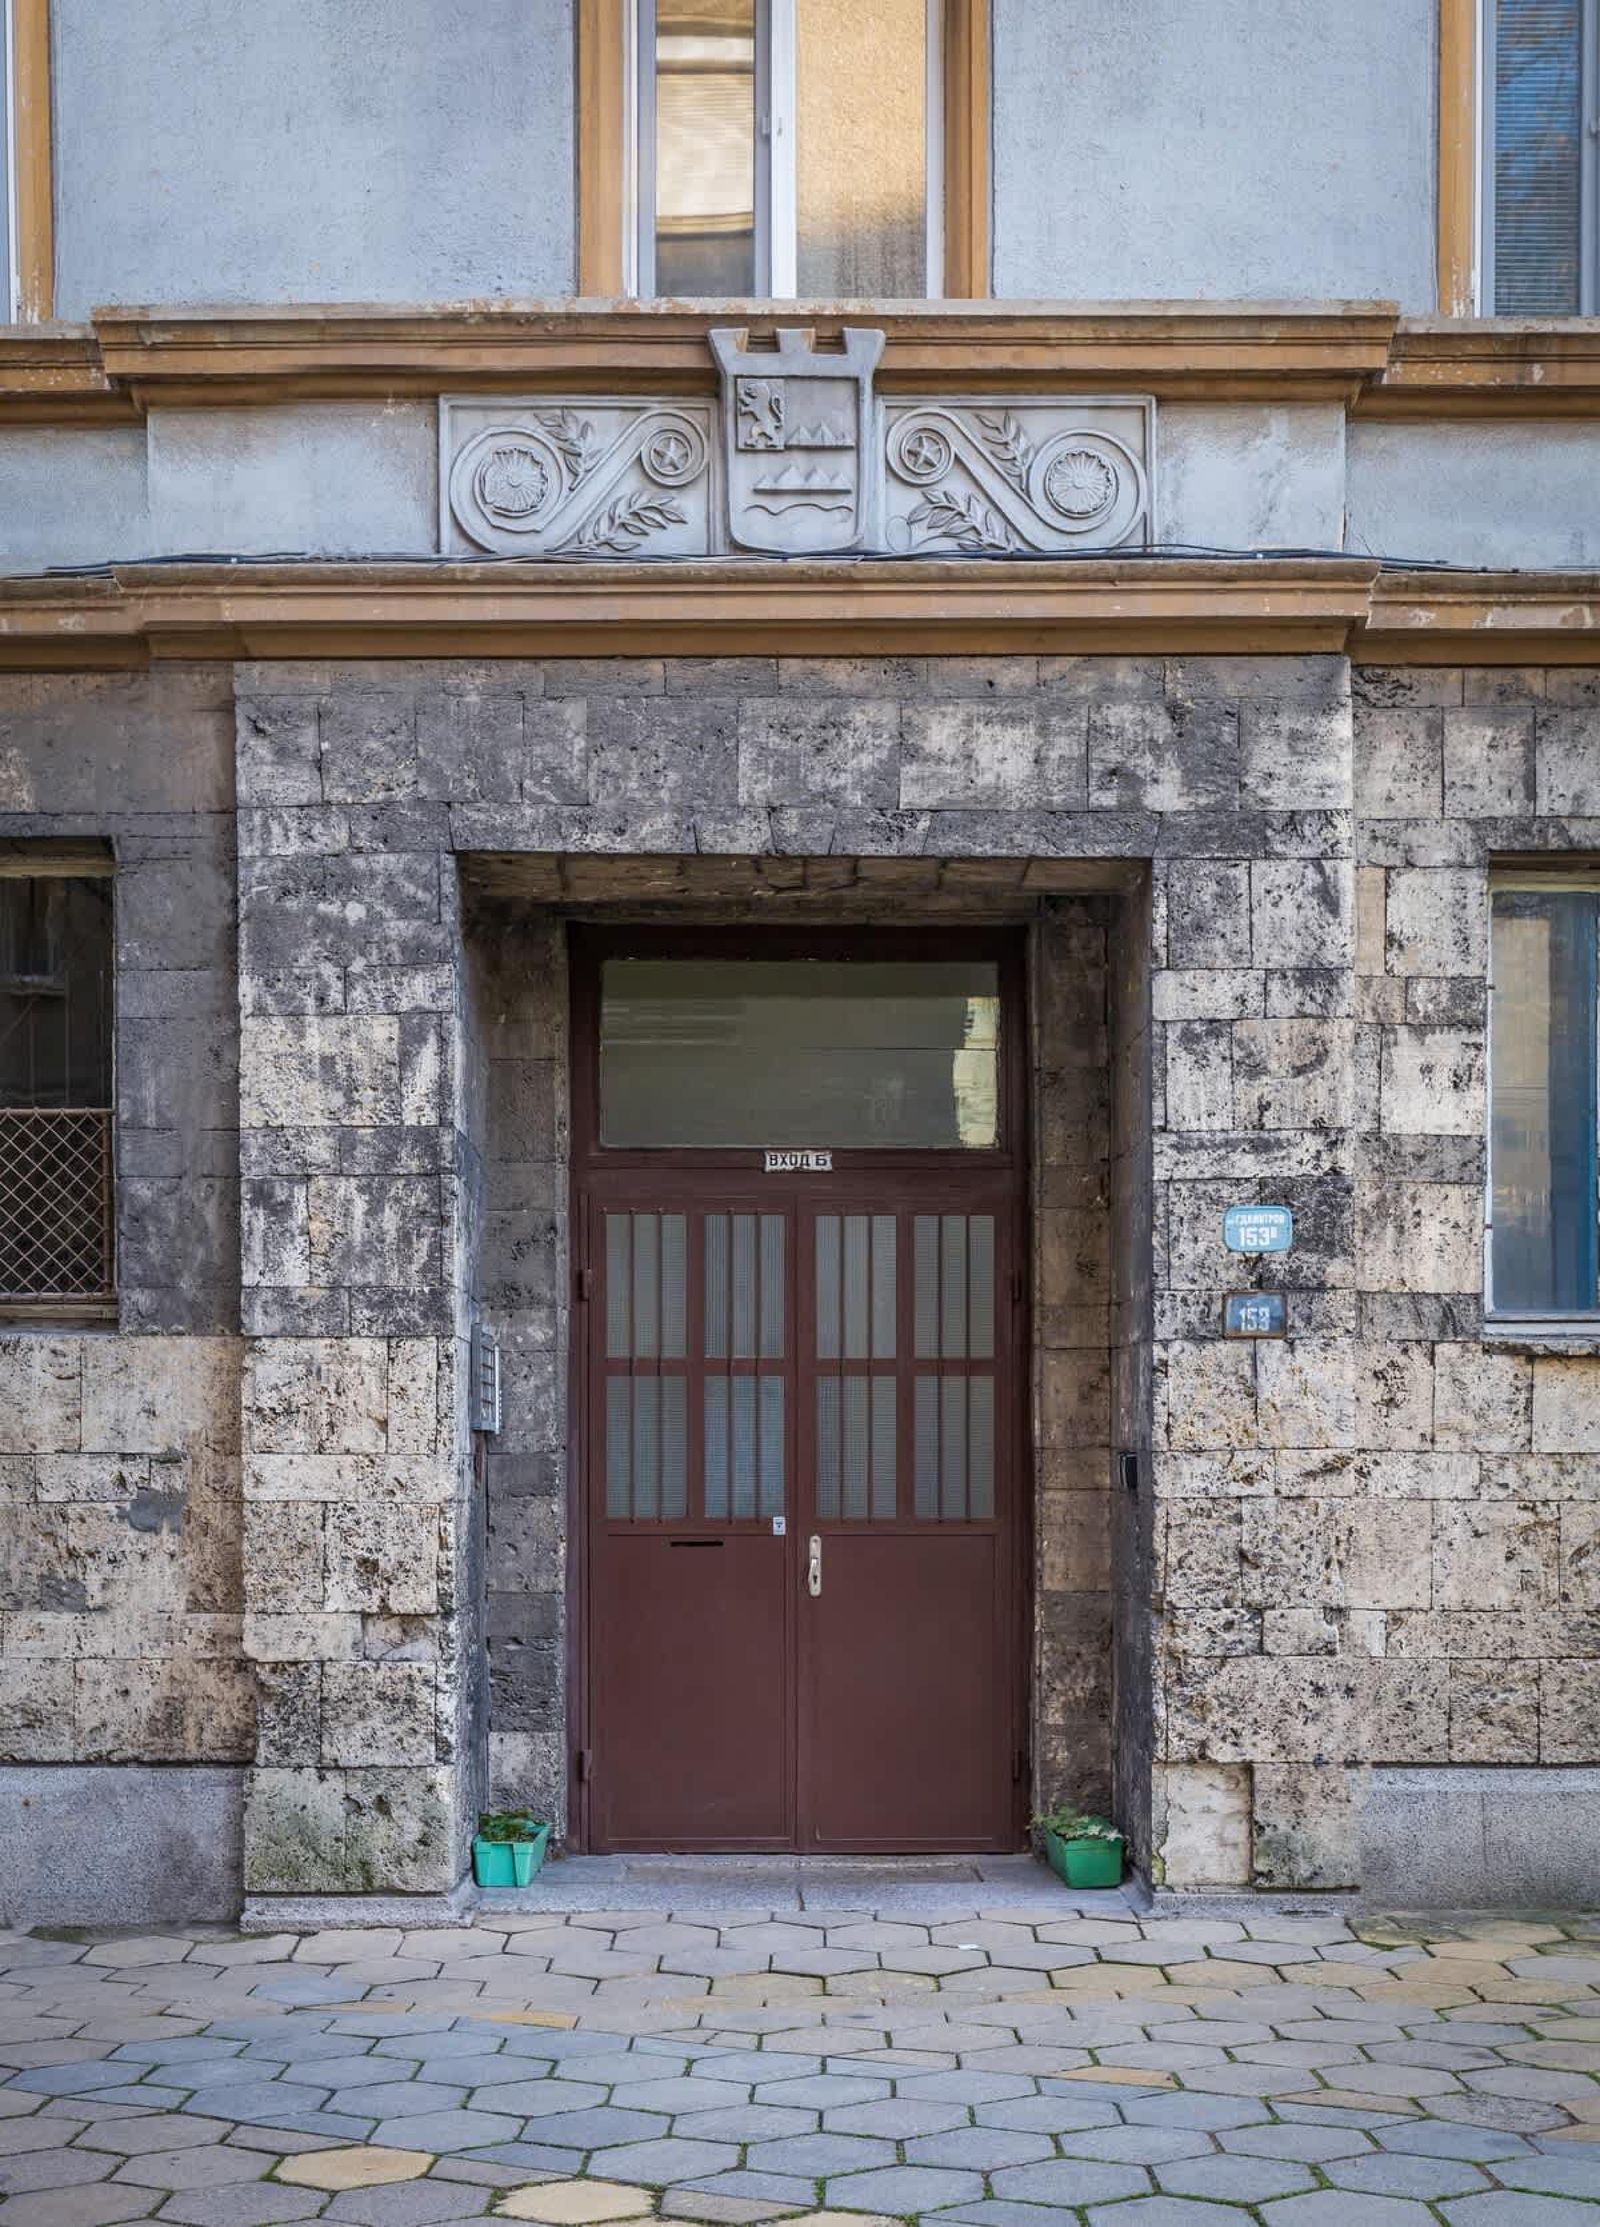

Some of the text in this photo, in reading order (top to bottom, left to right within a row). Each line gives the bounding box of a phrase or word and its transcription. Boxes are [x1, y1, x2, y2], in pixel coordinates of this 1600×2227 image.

[769, 1154, 828, 1167] ВХОД Б
[1239, 1306, 1270, 1331] 153
